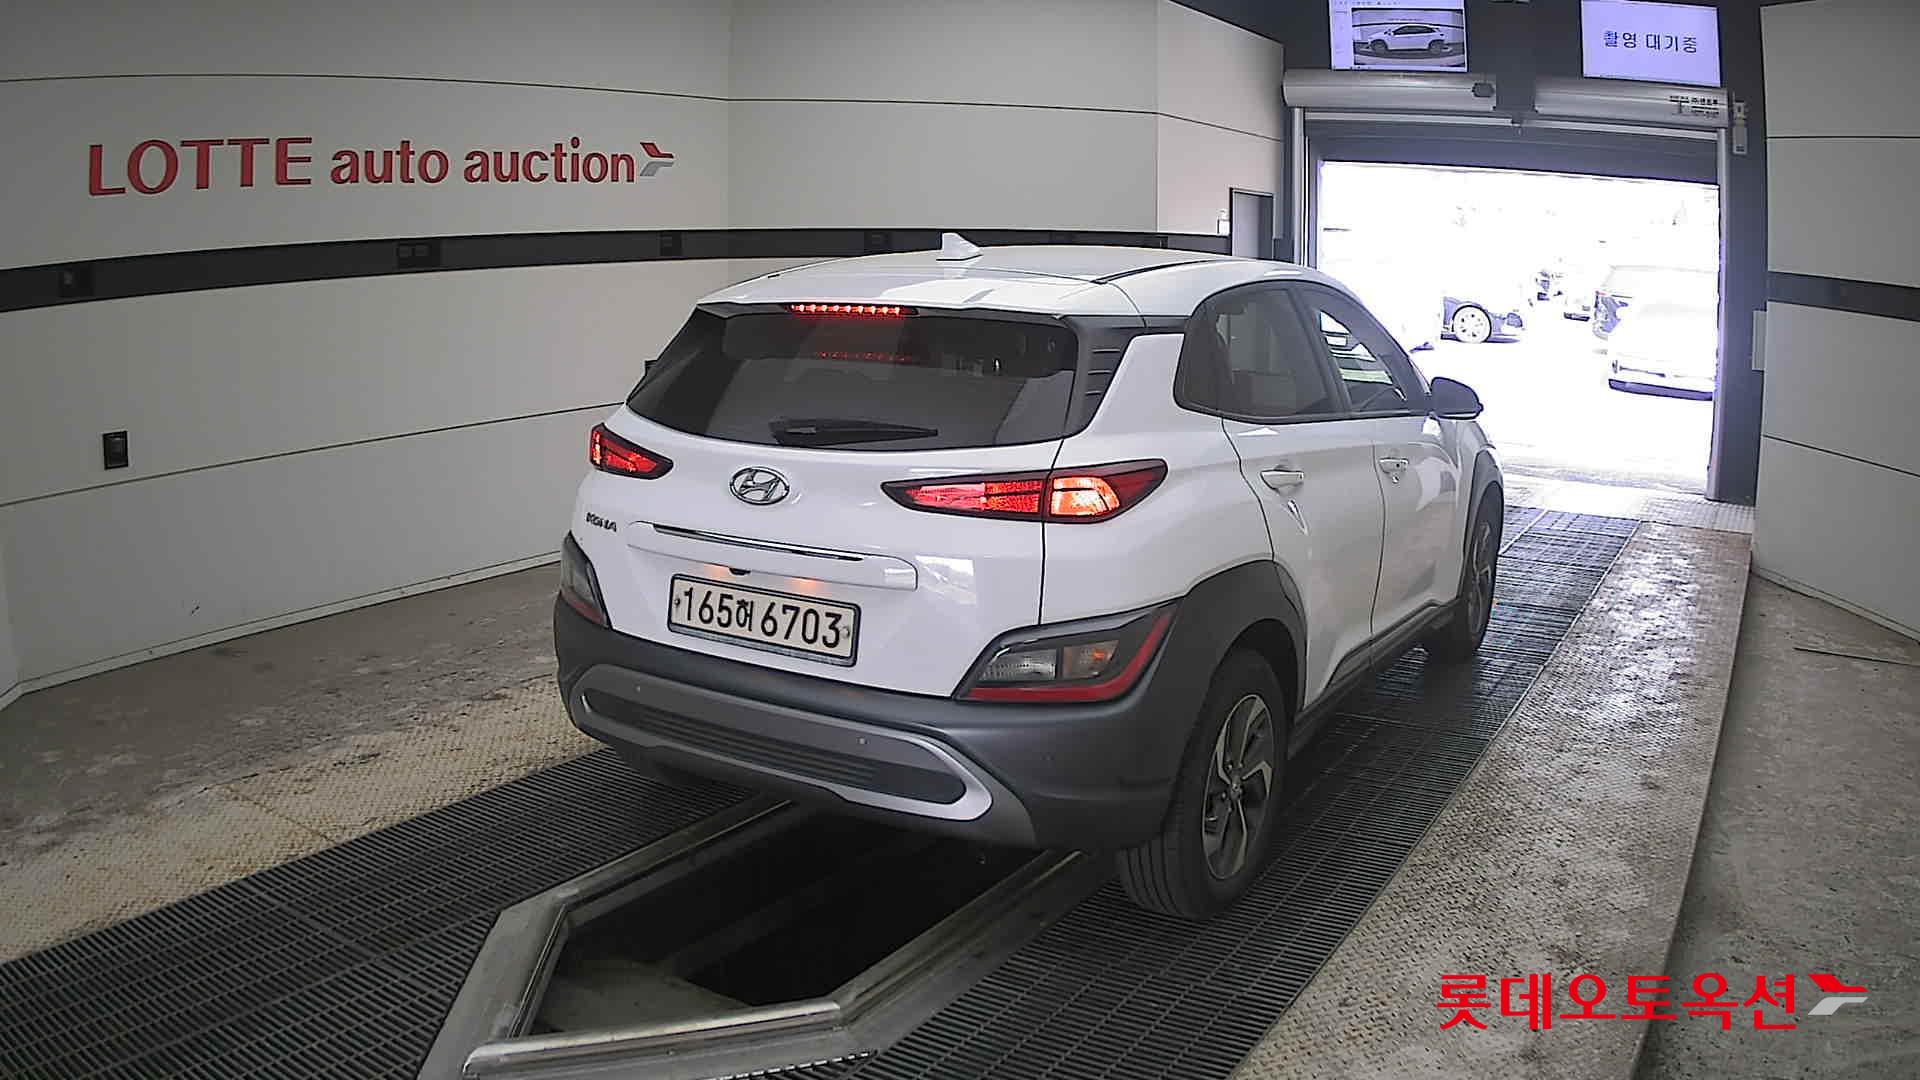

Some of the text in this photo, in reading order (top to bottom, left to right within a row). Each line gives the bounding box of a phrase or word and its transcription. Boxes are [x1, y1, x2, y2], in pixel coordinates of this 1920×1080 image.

[1645, 33, 1697, 54] 대기중
[88, 136, 636, 197] LOTTE auto auction
